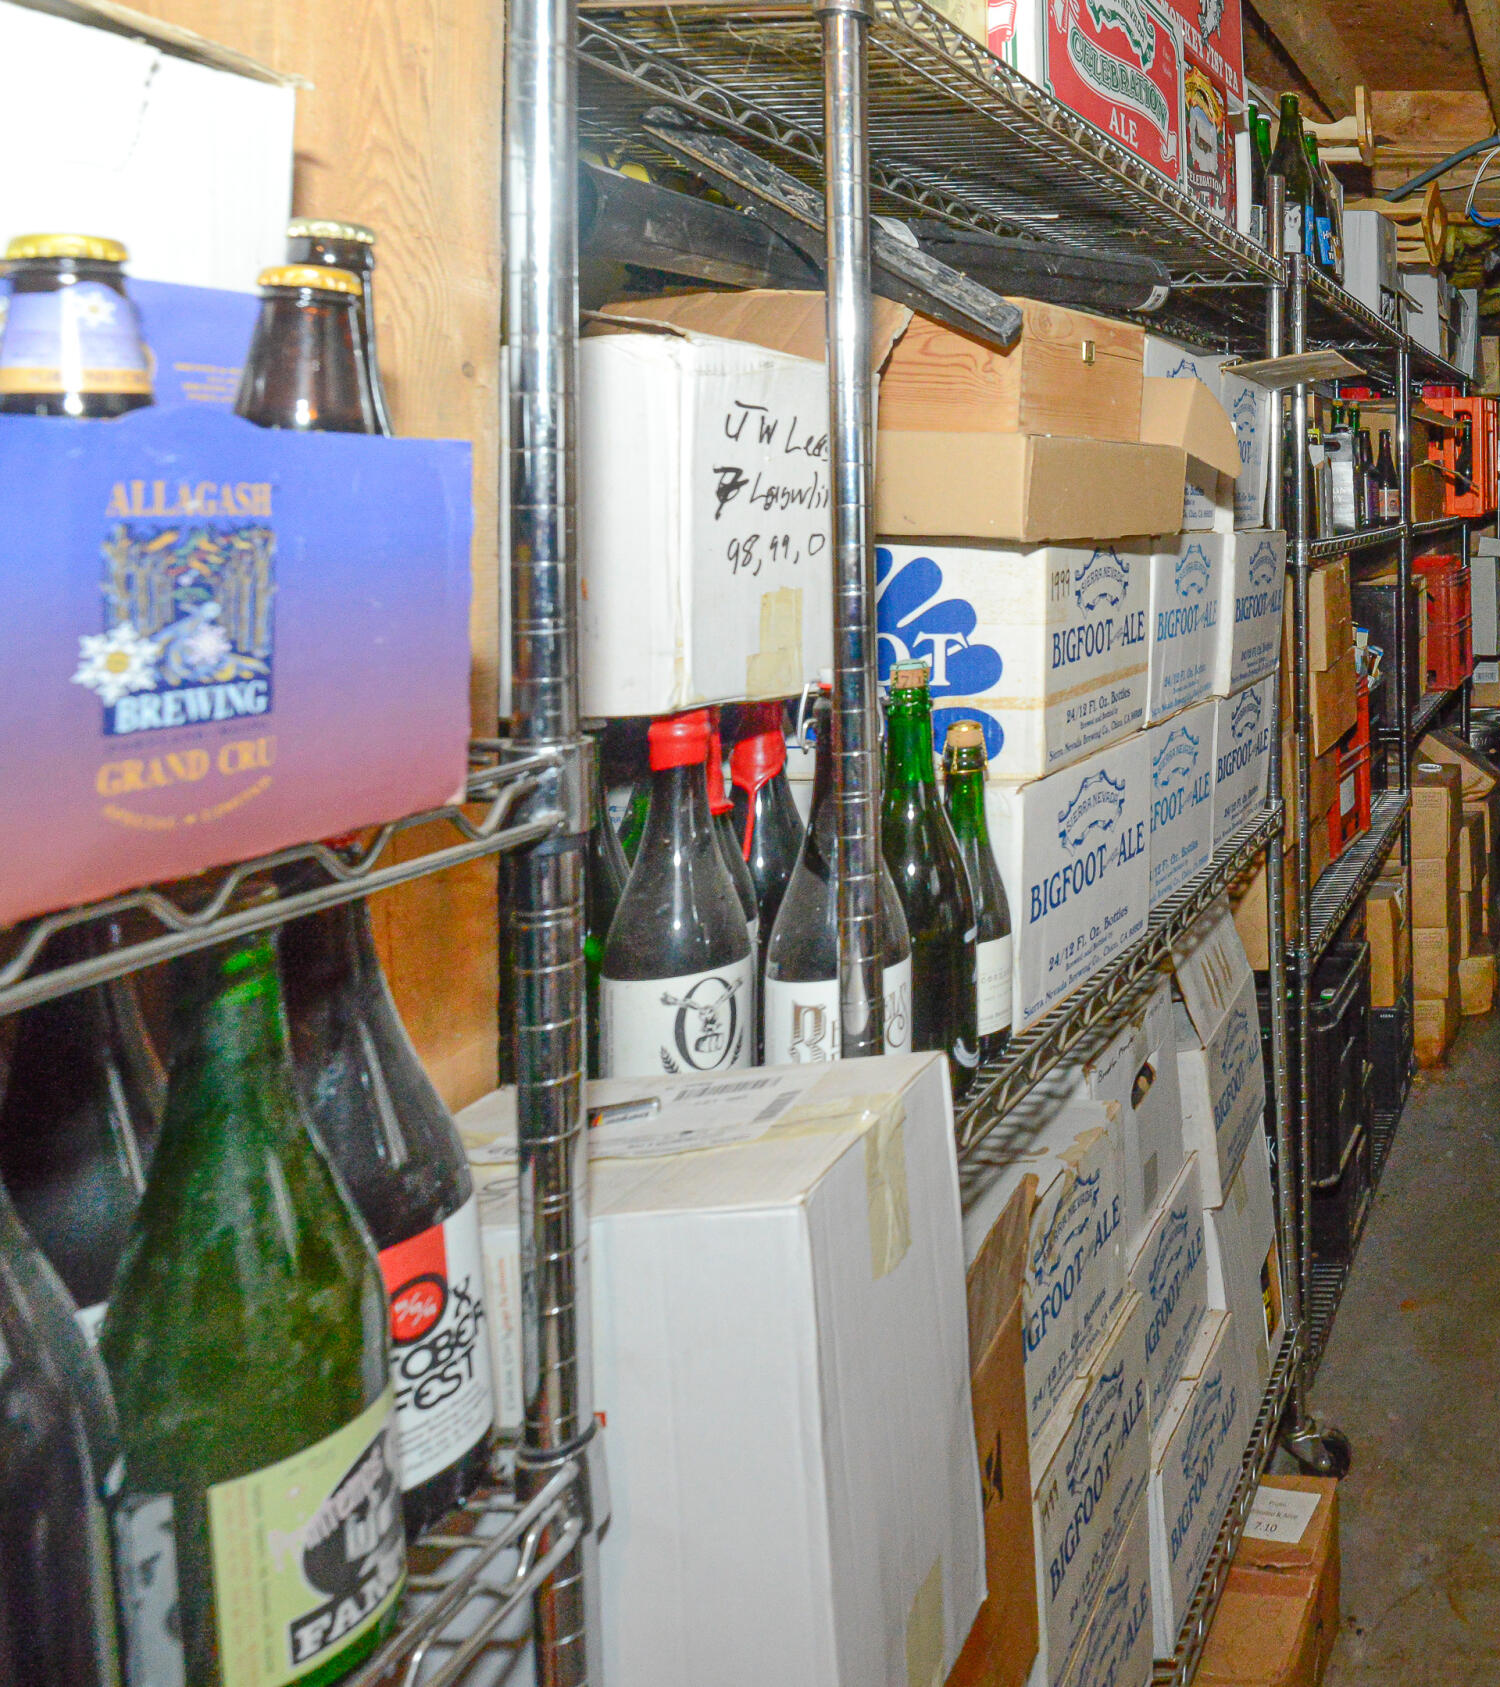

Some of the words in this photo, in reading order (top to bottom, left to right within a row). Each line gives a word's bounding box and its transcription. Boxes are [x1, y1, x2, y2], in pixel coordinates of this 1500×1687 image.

[1070, 26, 1169, 130] CELEBRATION
[1224, 61, 1240, 94] IPA
[1109, 107, 1139, 149] ALE
[1189, 172, 1222, 196] ELEBRATION
[106, 480, 273, 518] ALLAGASH
[1051, 568, 1071, 602] 1999
[1235, 592, 1268, 623] BIGFOOT
[1269, 588, 1282, 614] ALE
[1052, 618, 1114, 669] BIGFOOT
[1121, 610, 1146, 647] ALE
[1157, 604, 1199, 642] BIGFOOT
[1203, 599, 1218, 629] ALE
[114, 680, 269, 735] BREWING
[96, 748, 211, 797] GRAND
[218, 735, 277, 776] CRU
[1217, 739, 1253, 784] BIGFOOT
[1254, 728, 1269, 758] ALE
[1150, 786, 1185, 834] FOOT
[1192, 771, 1210, 809] ALE
[1029, 843, 1107, 924] BIGFOOT
[1117, 820, 1145, 867] ALE
[1213, 1062, 1244, 1132] BIGFOOT
[1022, 1247, 1084, 1363] IGFOOT
[1093, 1194, 1121, 1257] ALE
[1049, 1444, 1114, 1602] BIGFOOT
[1120, 1378, 1144, 1450] ALE
[1171, 1437, 1216, 1563] BIGFOOT
